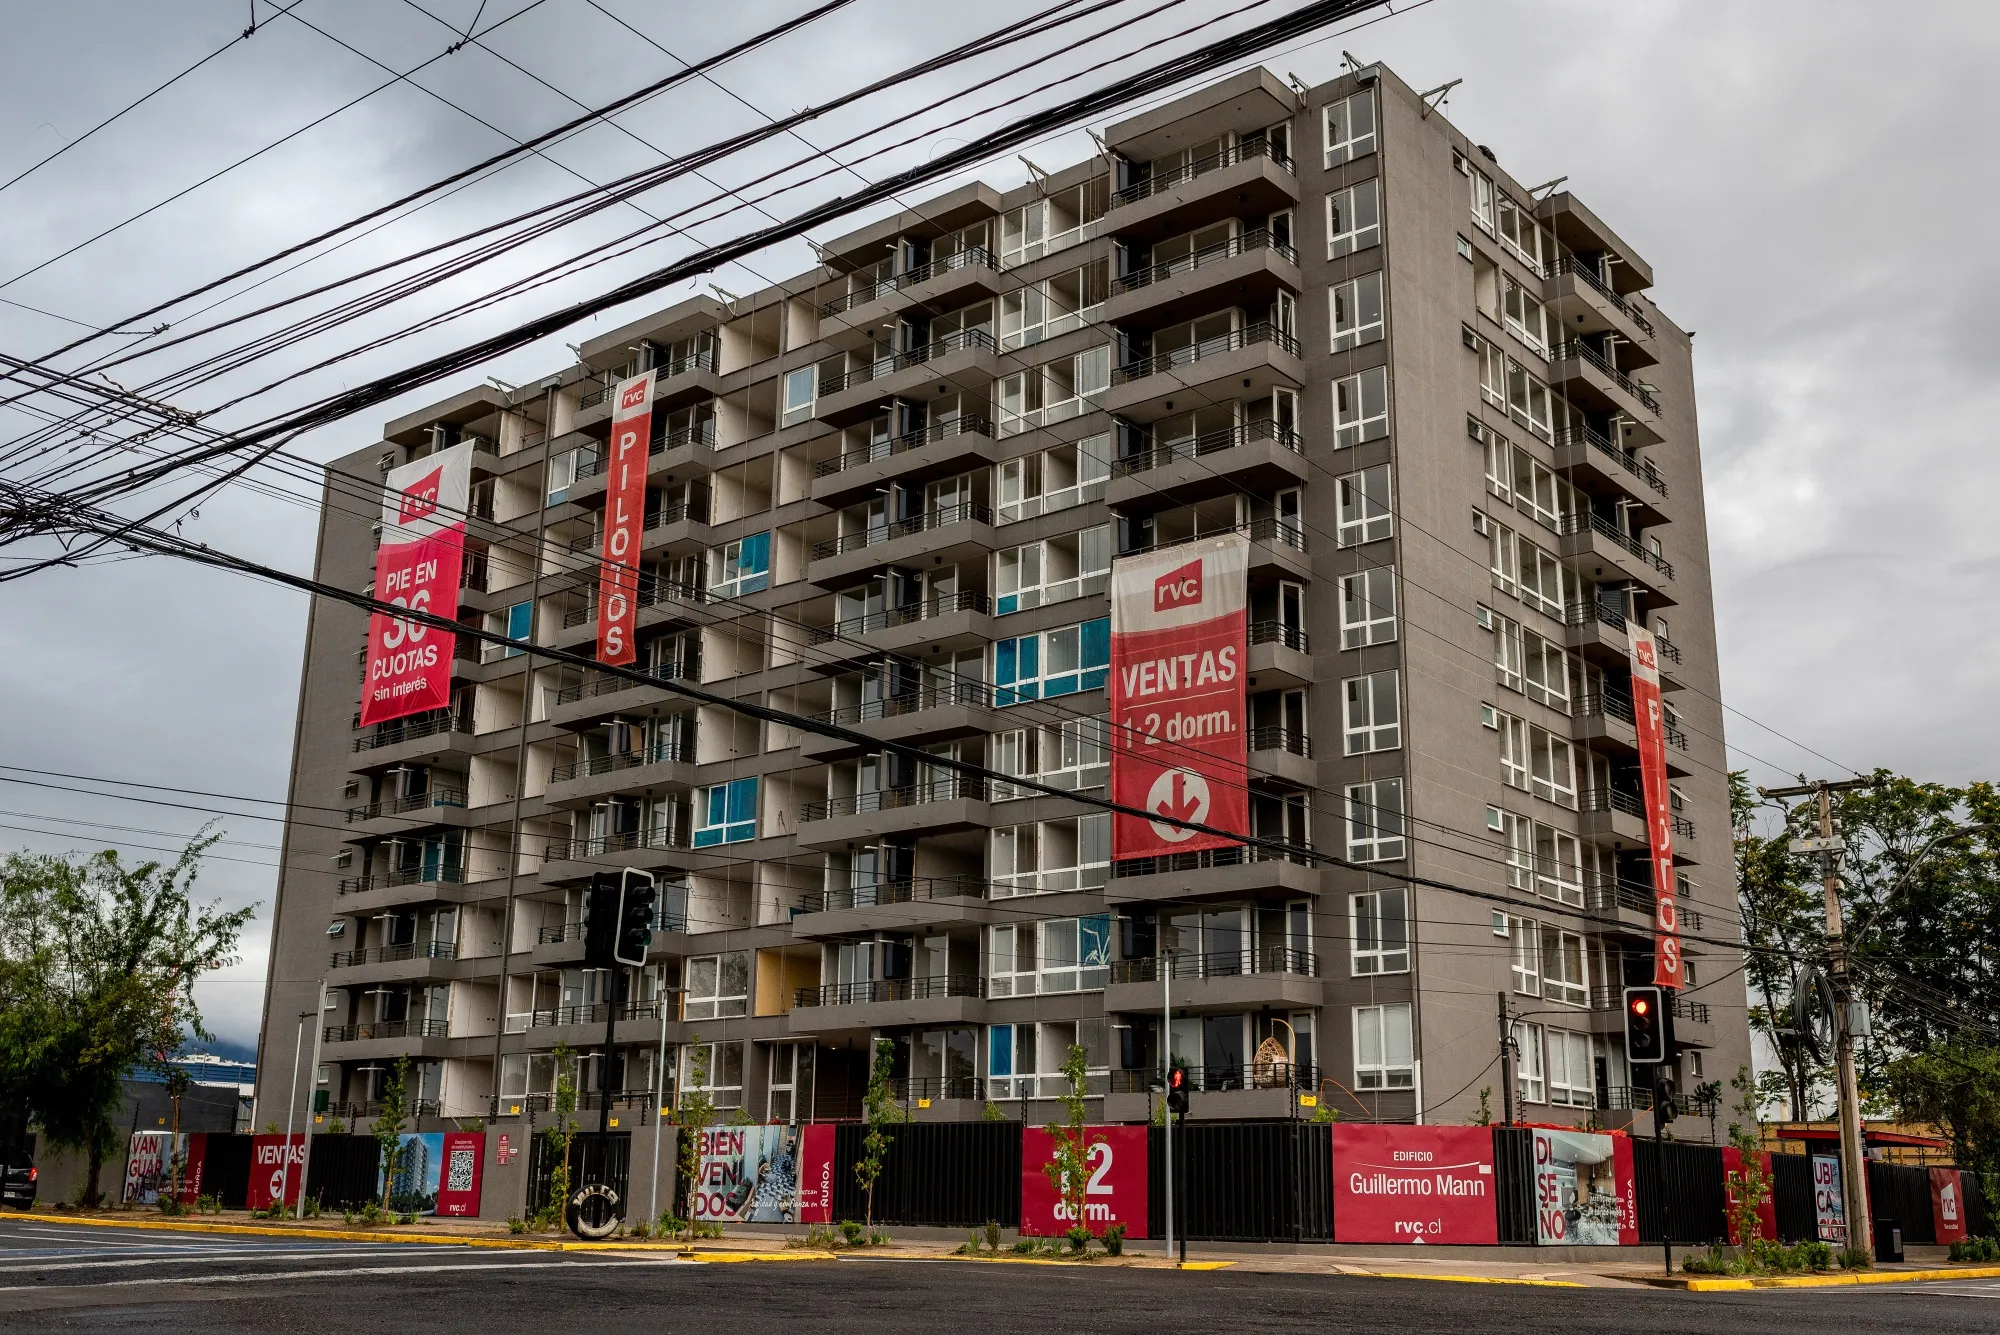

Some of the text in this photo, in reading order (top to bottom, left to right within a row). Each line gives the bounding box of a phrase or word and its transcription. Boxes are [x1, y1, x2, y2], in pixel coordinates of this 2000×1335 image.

[623, 386, 645, 404] rvc
[401, 486, 436, 512] rvc
[605, 432, 637, 656] PILOTOS
[385, 558, 438, 594] PIE EN
[1158, 578, 1198, 604] rvc
[383, 588, 431, 650] 36
[372, 645, 438, 681] CUOTAS
[1121, 645, 1237, 699] VENTAS
[374, 675, 427, 702] sin interés
[1166, 709, 1237, 743] dorm.
[132, 1136, 158, 1154] VAN
[257, 1144, 306, 1165] VENTAS
[699, 1131, 744, 1156] BIEN
[1393, 1150, 1433, 1162] EDIFICIO
[1535, 1136, 1553, 1166] DI
[129, 1159, 163, 1178] GUAR
[698, 1161, 744, 1187] VENI
[1813, 1161, 1834, 1185] UBI
[820, 1160, 831, 1208] ÑUÑOA
[1350, 1172, 1485, 1197] Guillermo Mann
[1537, 1172, 1559, 1203] SE
[449, 1202, 467, 1212] rvc.cl
[695, 1191, 738, 1217] DOS
[1626, 1178, 1636, 1230] ÑUÑOA
[1816, 1189, 1836, 1214] CA
[1942, 1198, 1955, 1213] rvc
[1395, 1218, 1442, 1234] rvc.cl
[1540, 1201, 1566, 1240] ÑO
